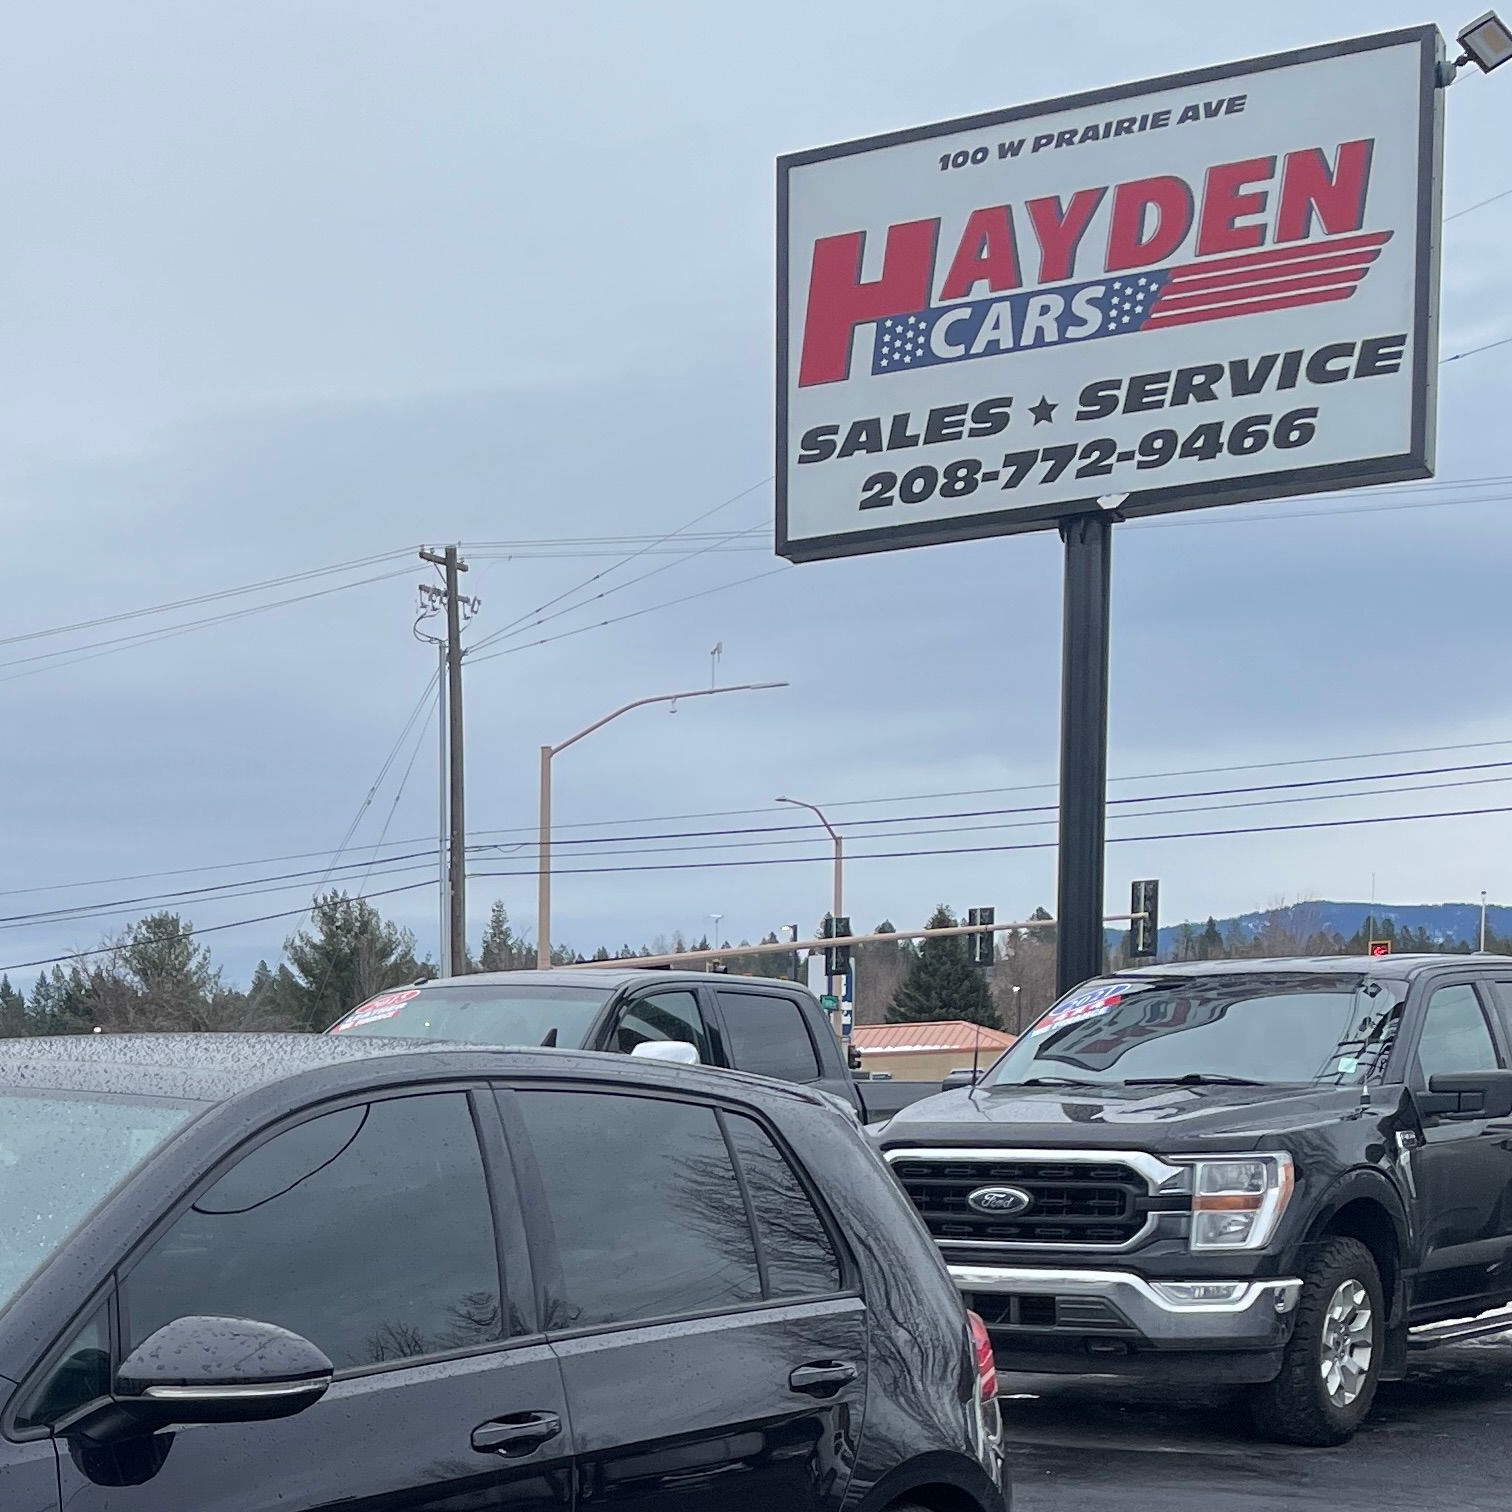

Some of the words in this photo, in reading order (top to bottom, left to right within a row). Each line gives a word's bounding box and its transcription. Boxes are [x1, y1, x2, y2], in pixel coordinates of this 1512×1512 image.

[938, 146, 989, 171] 100
[998, 139, 1026, 159] W
[1031, 110, 1172, 154] PRAIRIE
[1176, 94, 1247, 125] AVE
[798, 138, 1375, 388] HAYDEN
[929, 286, 1107, 359] CARS
[798, 397, 1014, 464] SALES
[1075, 333, 1408, 422] SERVICE
[858, 407, 1319, 511] 208-772-9466
[981, 1192, 1015, 1208] Ford
